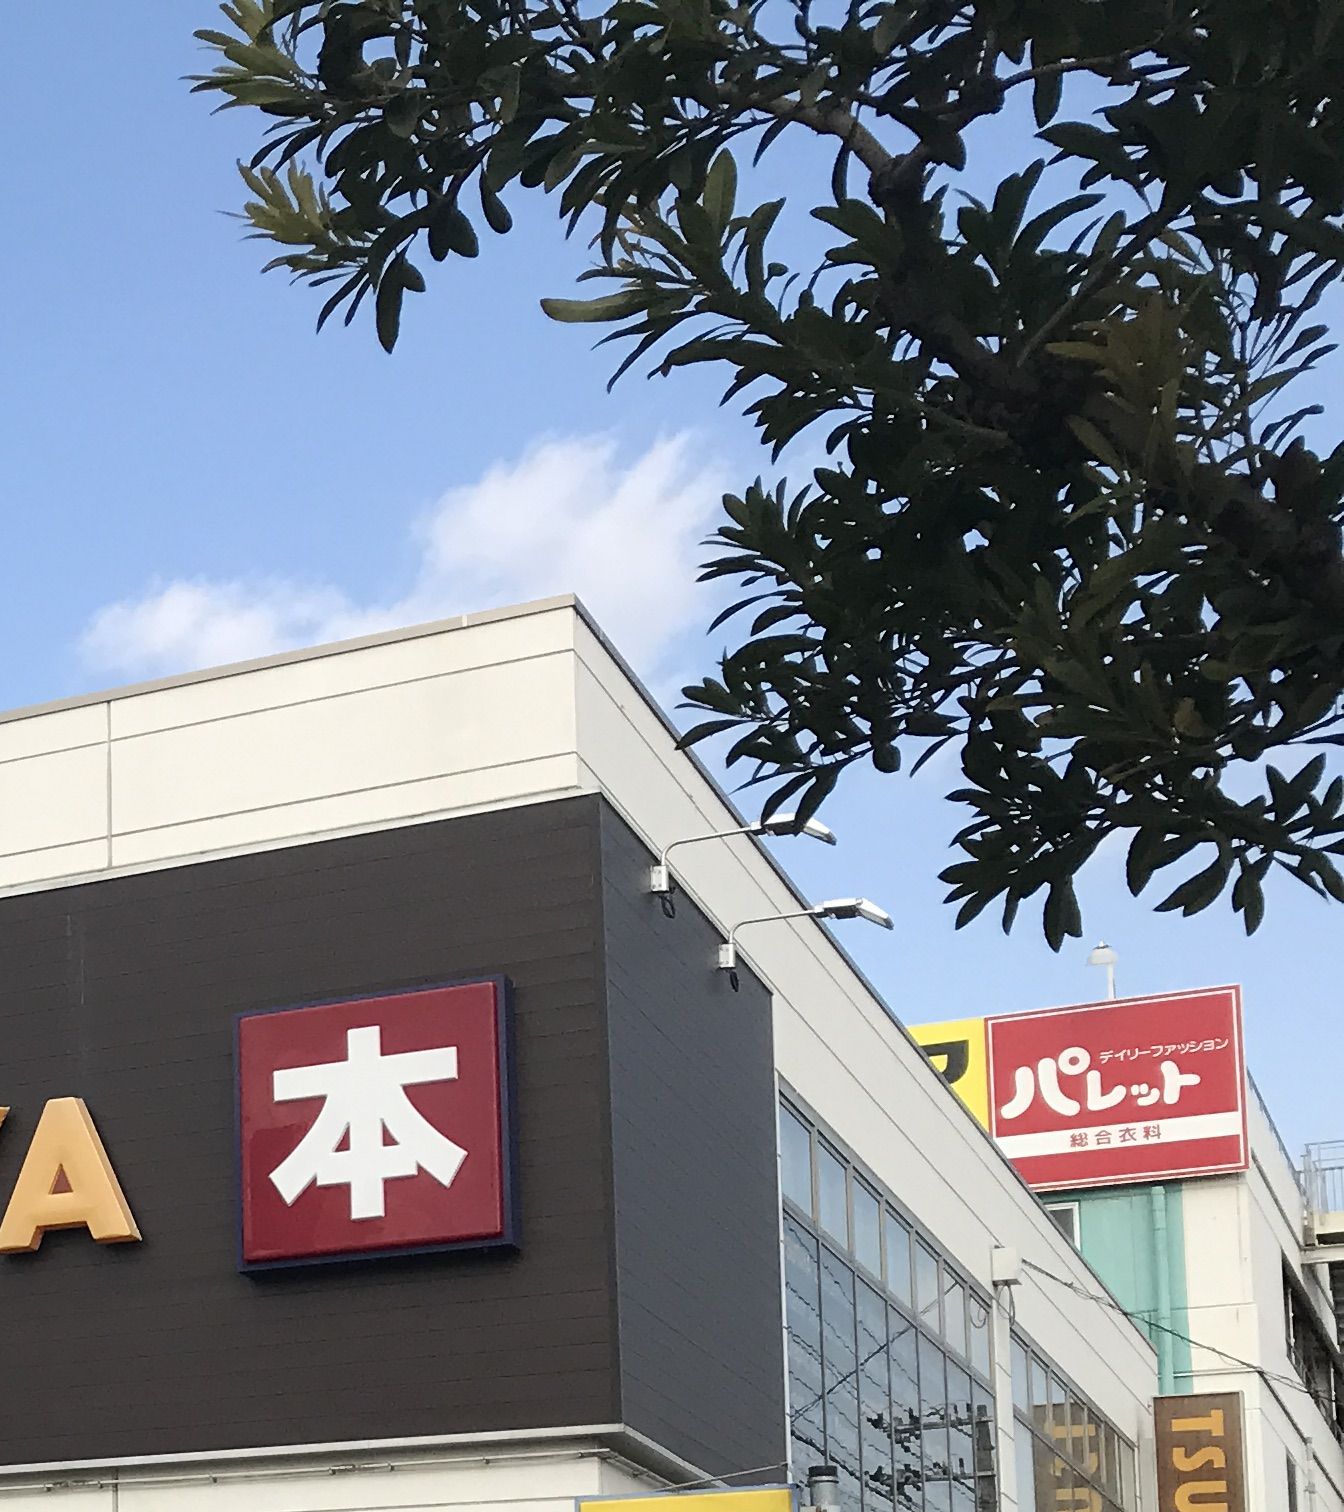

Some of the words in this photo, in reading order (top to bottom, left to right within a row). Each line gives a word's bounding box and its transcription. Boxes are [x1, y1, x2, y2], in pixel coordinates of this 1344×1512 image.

[1000, 1047, 1201, 1120] パレット
[269, 1024, 468, 1220] 本
[1070, 1125, 1162, 1148] 総合衣料
